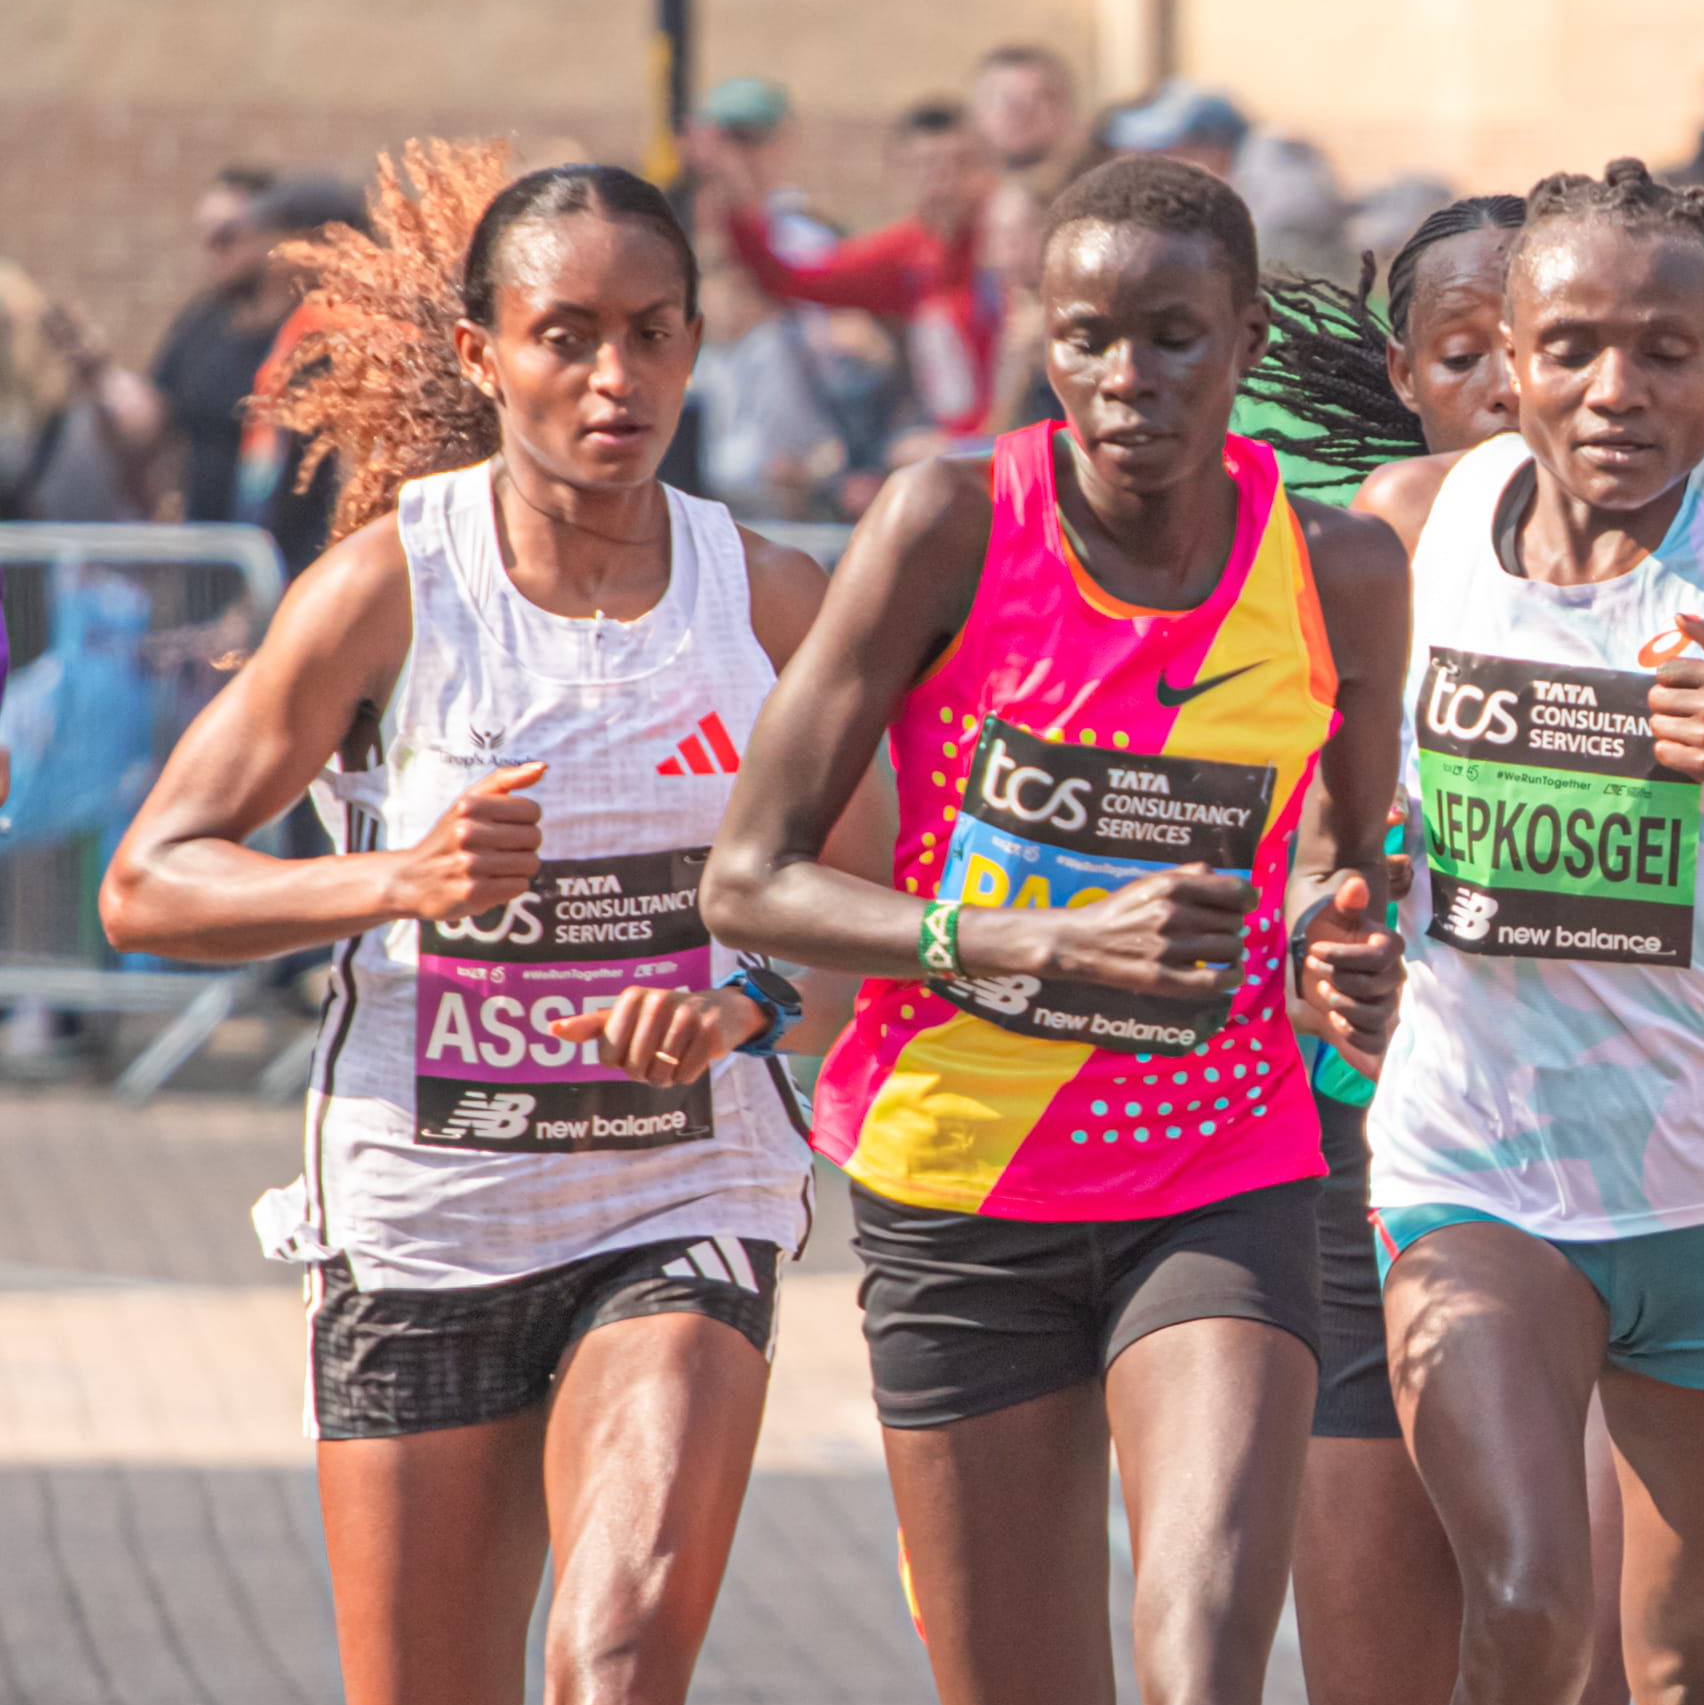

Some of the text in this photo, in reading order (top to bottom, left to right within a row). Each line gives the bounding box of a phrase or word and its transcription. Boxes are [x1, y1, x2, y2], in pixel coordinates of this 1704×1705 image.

[1426, 666, 1518, 745] tcs
[1532, 680, 1598, 707] TATA
[1530, 705, 1653, 737] CONSULTAN
[1529, 728, 1625, 759] SERVICES
[981, 738, 1092, 831] tcs
[1107, 768, 1170, 794] TATA
[1496, 770, 1592, 792] #WeRunTogether
[1101, 793, 1251, 828] CONSULTANCY
[1096, 818, 1192, 845] SERVICES
[1431, 789, 1682, 887] JEPKOSGEI
[555, 874, 622, 896] TATA
[555, 887, 697, 920] CONSULTANCY
[554, 920, 652, 944] SERVICES
[1498, 925, 1662, 952] new balance
[1033, 1007, 1196, 1046] new balance
[536, 1110, 687, 1139] new balance
